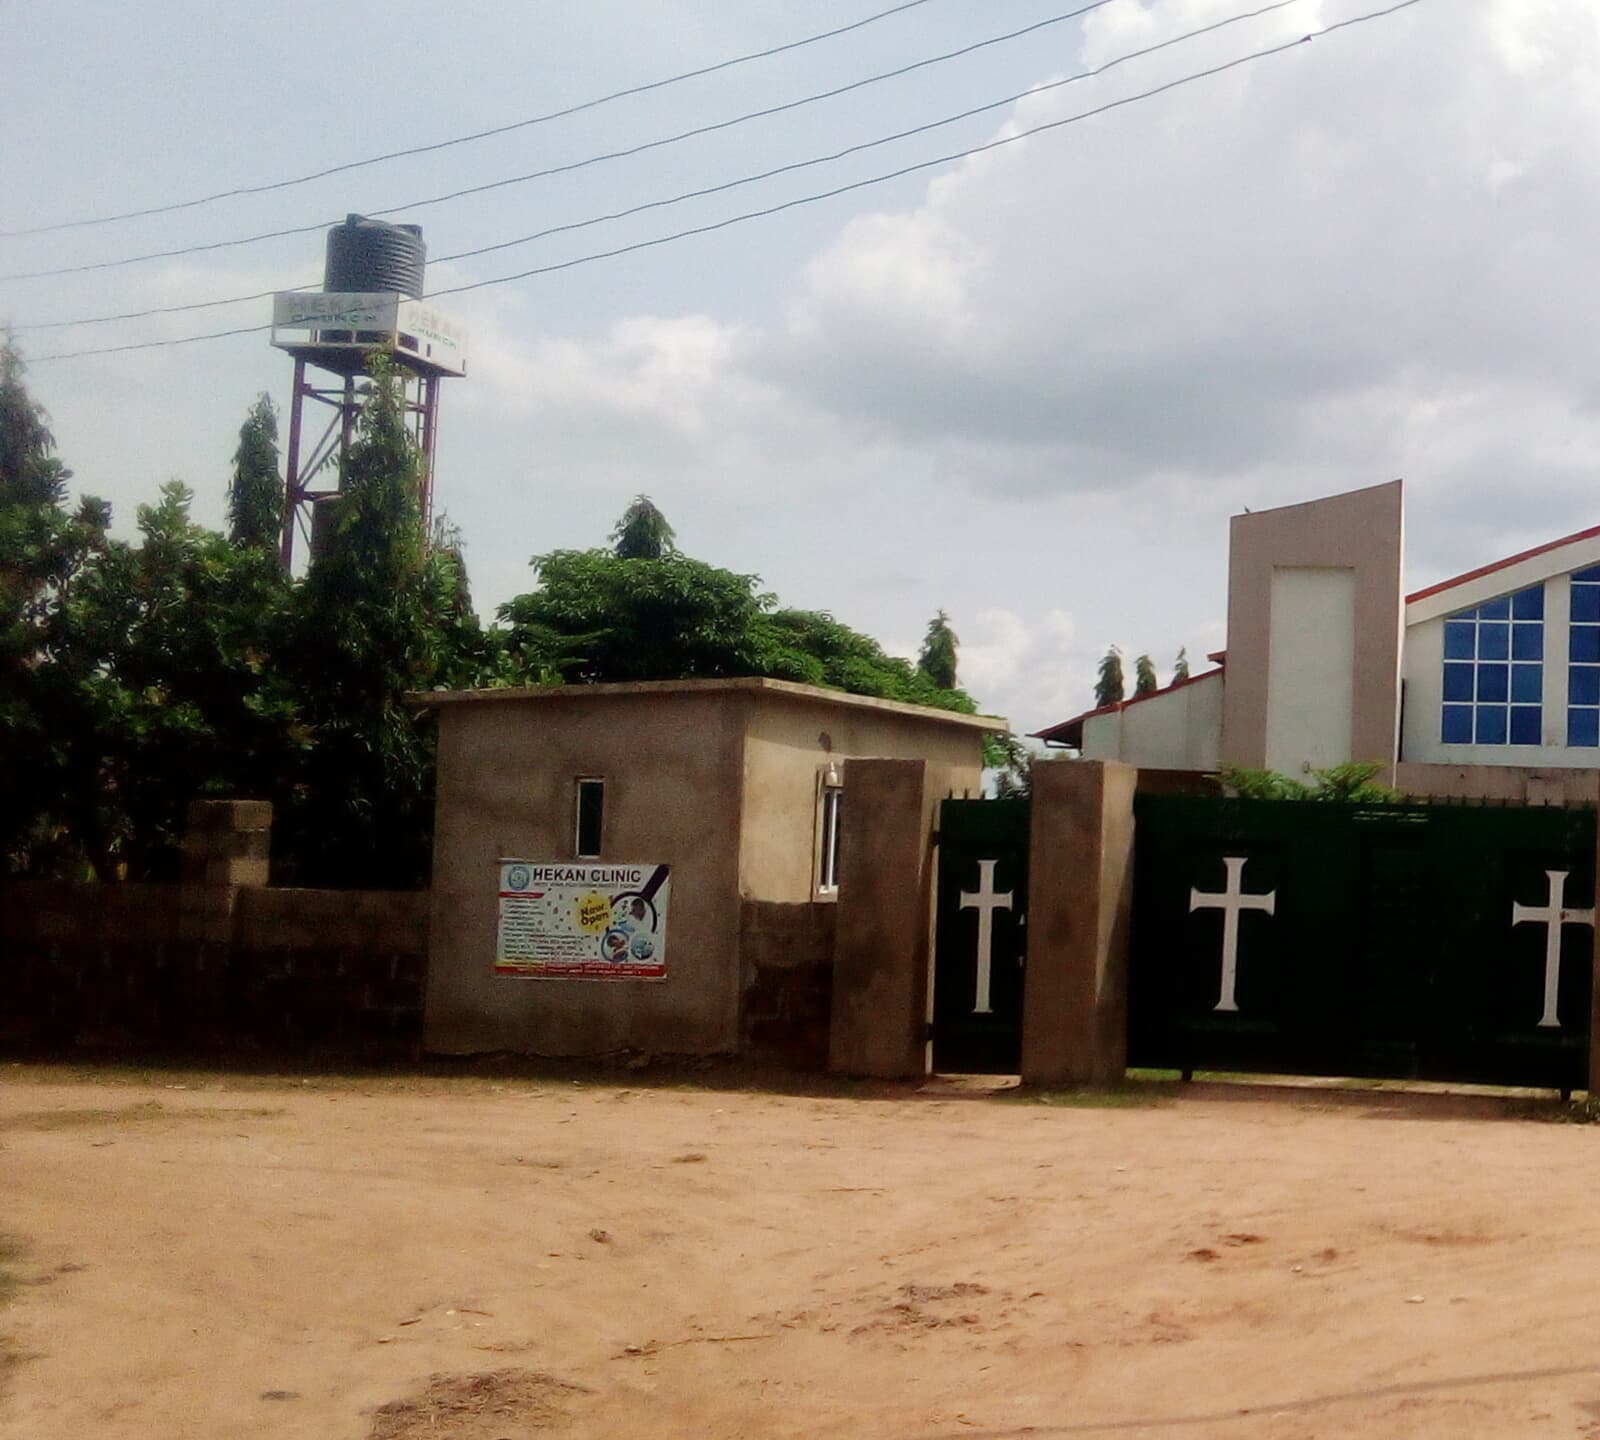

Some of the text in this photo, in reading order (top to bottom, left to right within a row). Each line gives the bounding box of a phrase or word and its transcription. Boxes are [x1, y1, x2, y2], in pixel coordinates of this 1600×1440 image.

[532, 868, 641, 883] HEKAN CLINIC
[580, 904, 604, 915] Now
[580, 912, 609, 925] Open
